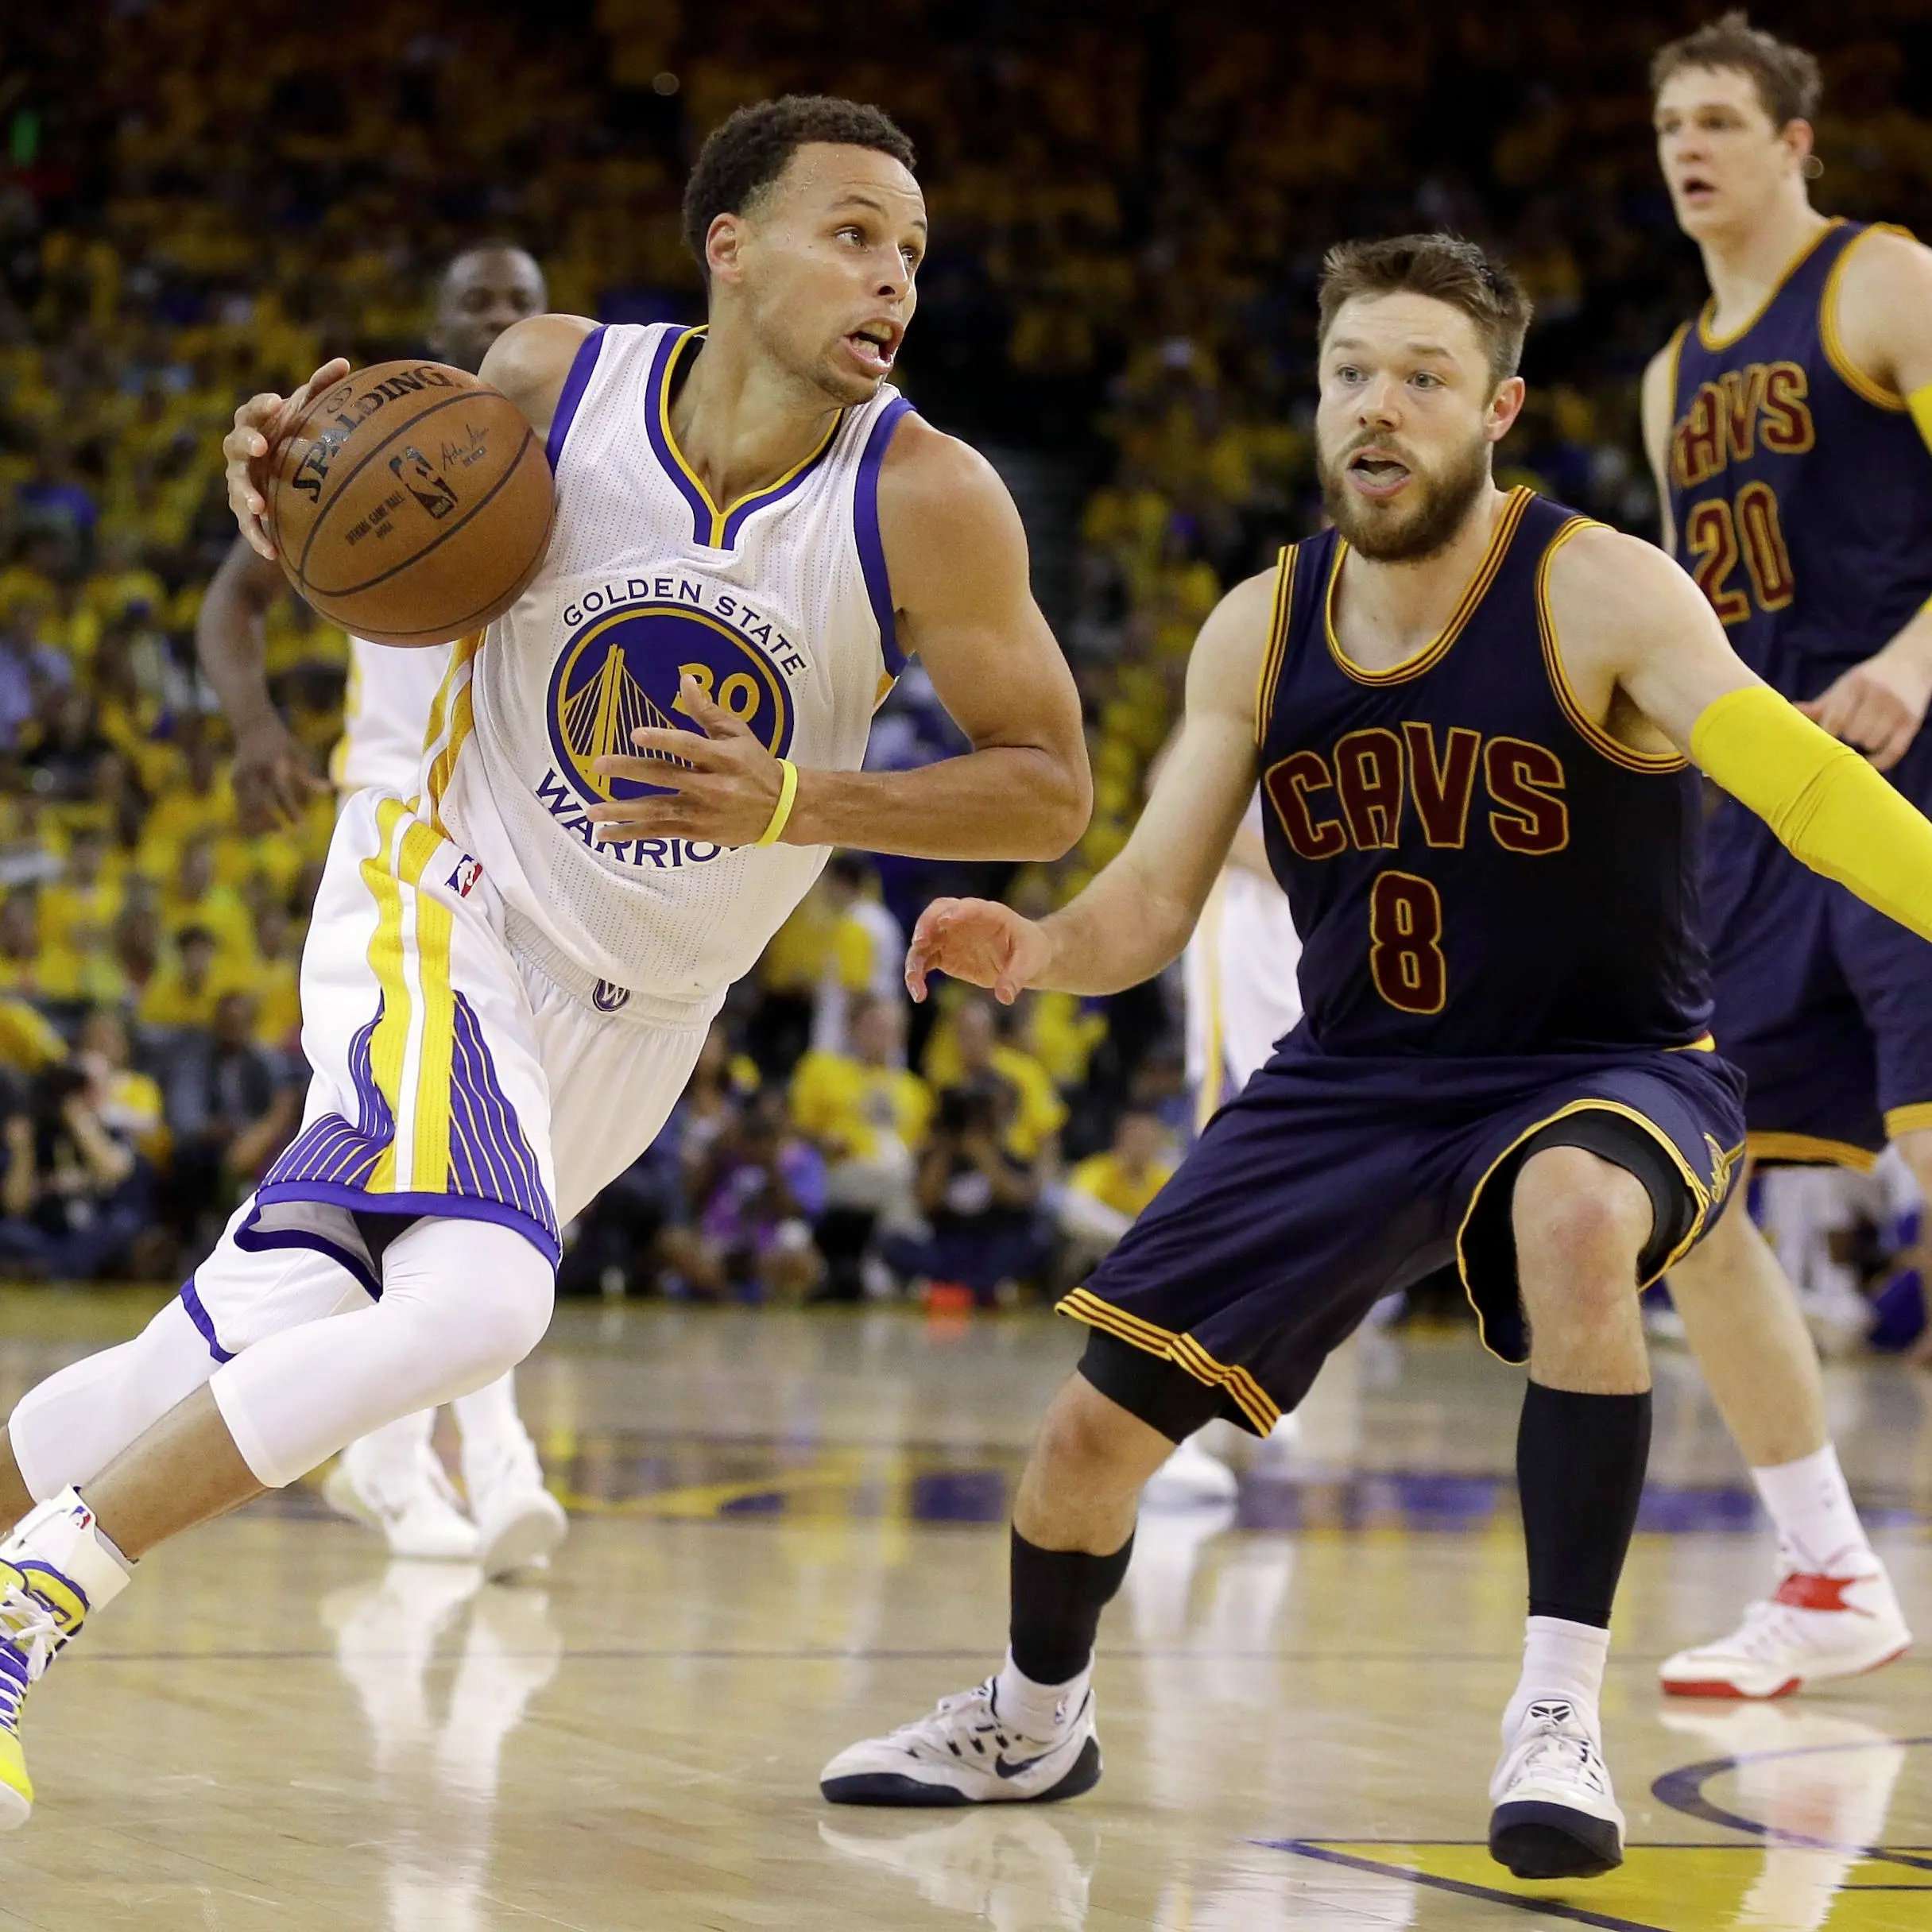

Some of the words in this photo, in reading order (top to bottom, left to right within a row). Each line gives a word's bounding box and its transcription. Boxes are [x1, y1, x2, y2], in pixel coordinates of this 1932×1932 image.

[292, 366, 454, 503] SPALDING
[1671, 361, 1816, 490] AVS
[1686, 481, 1795, 626] 20
[563, 578, 703, 626] GOLDEN
[715, 596, 807, 676] STATE
[536, 768, 739, 868] WARRIO
[1264, 721, 1570, 860] CAVS
[1370, 870, 1446, 1014] 8
